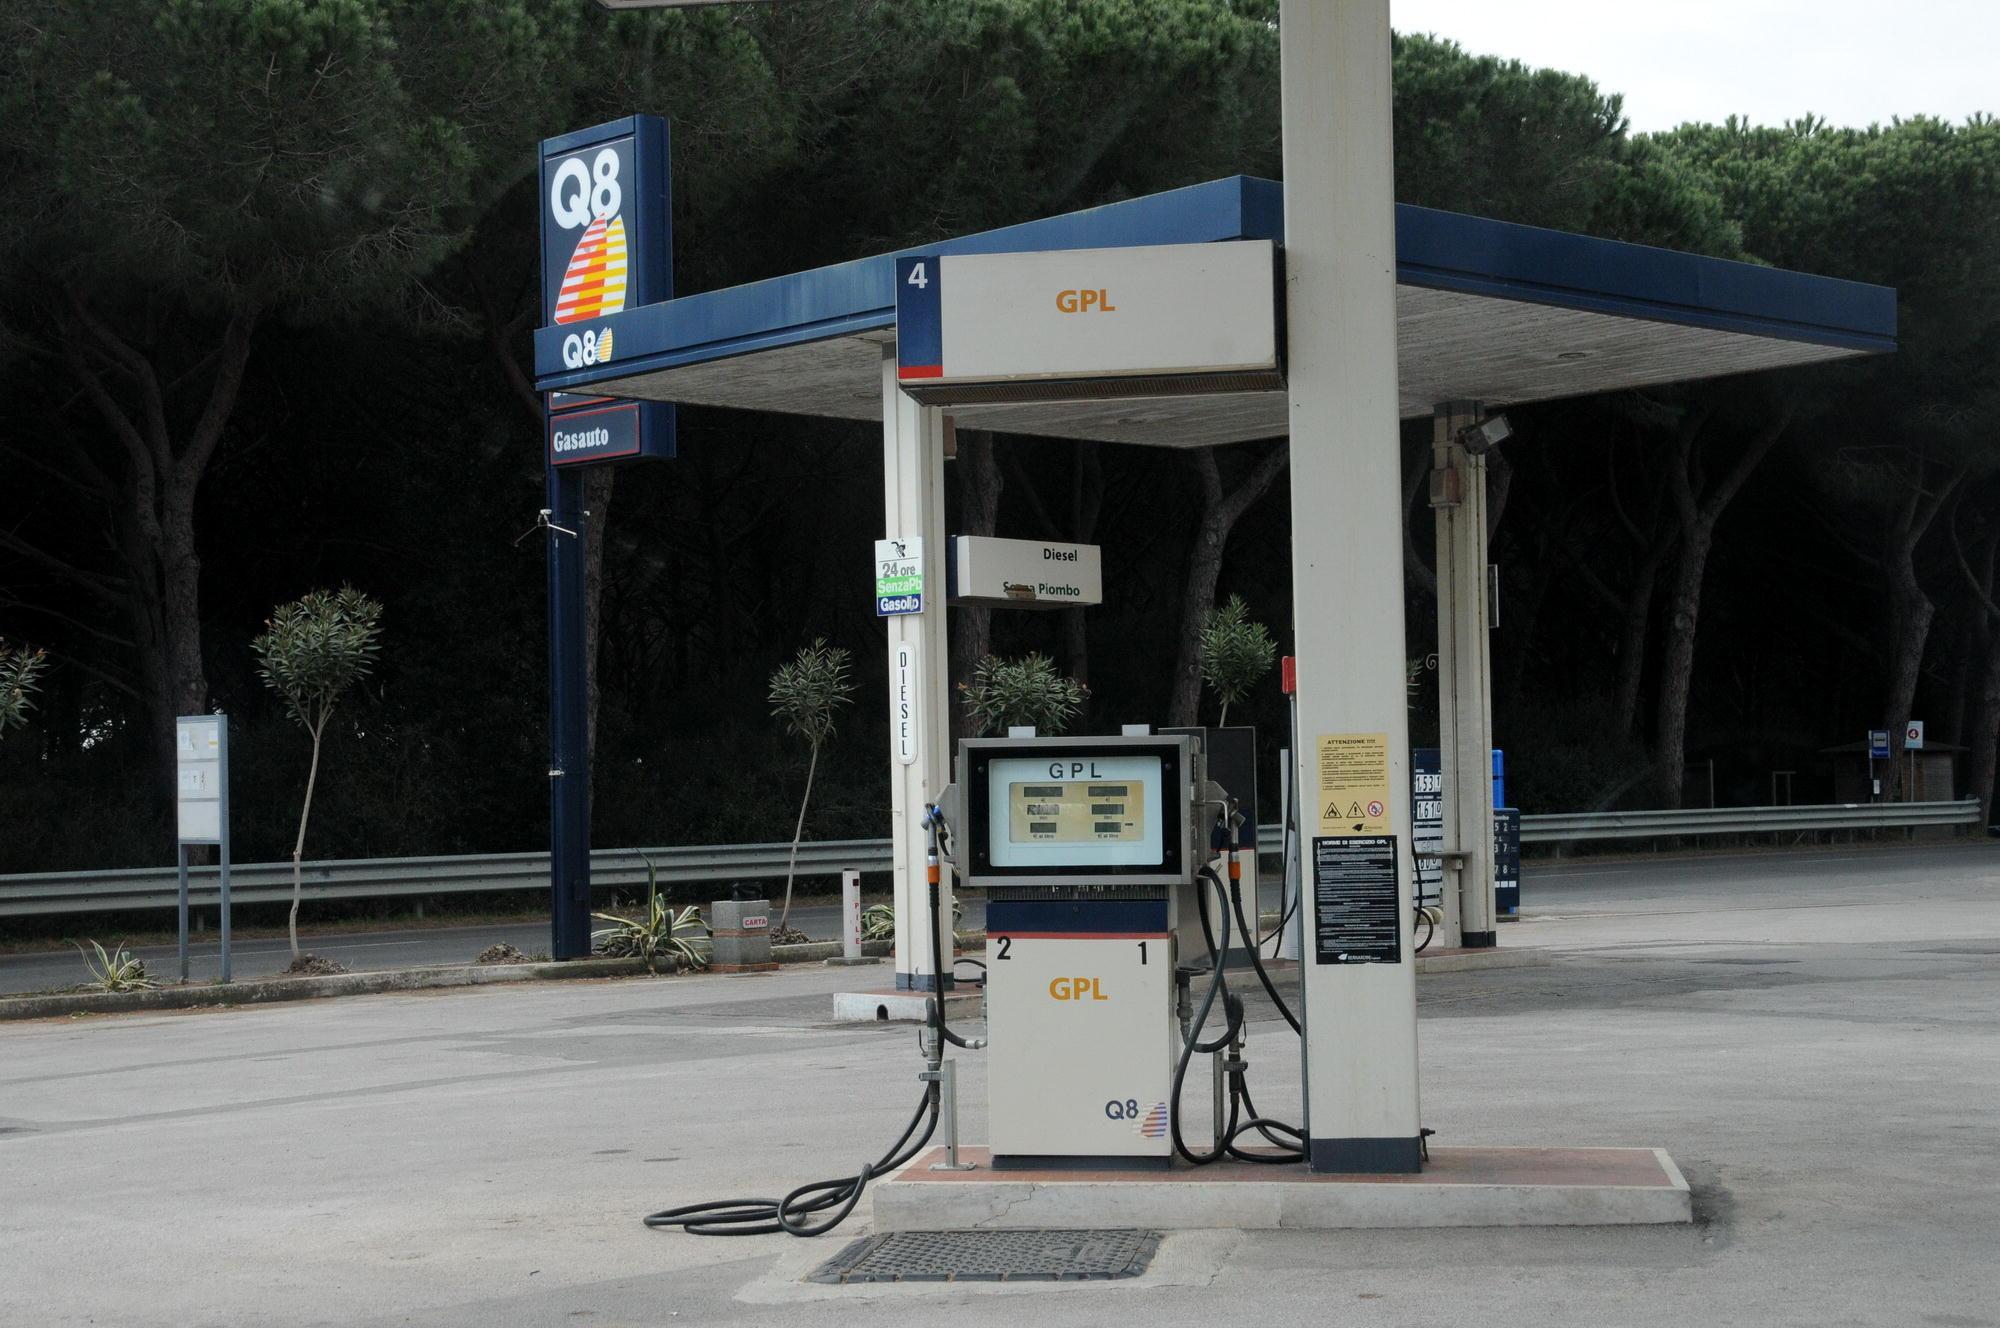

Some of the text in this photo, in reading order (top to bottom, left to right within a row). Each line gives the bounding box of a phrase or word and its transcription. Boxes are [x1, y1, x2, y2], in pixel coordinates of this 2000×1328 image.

[551, 148, 622, 230] Q8
[907, 262, 928, 289] 4
[1056, 289, 1116, 313] GPL
[563, 329, 597, 370] Q8
[554, 427, 609, 453] Gasauto
[1043, 548, 1078, 561] Diesel
[882, 562, 916, 578] 24 ore
[1038, 583, 1080, 596] Piombo
[900, 651, 908, 756] DIESEL
[1049, 762, 1102, 778] GPL
[744, 917, 767, 926] CARTA
[997, 936, 1147, 965] 2 1
[1049, 977, 1108, 1000] GPL
[1105, 1099, 1139, 1119] Q8
